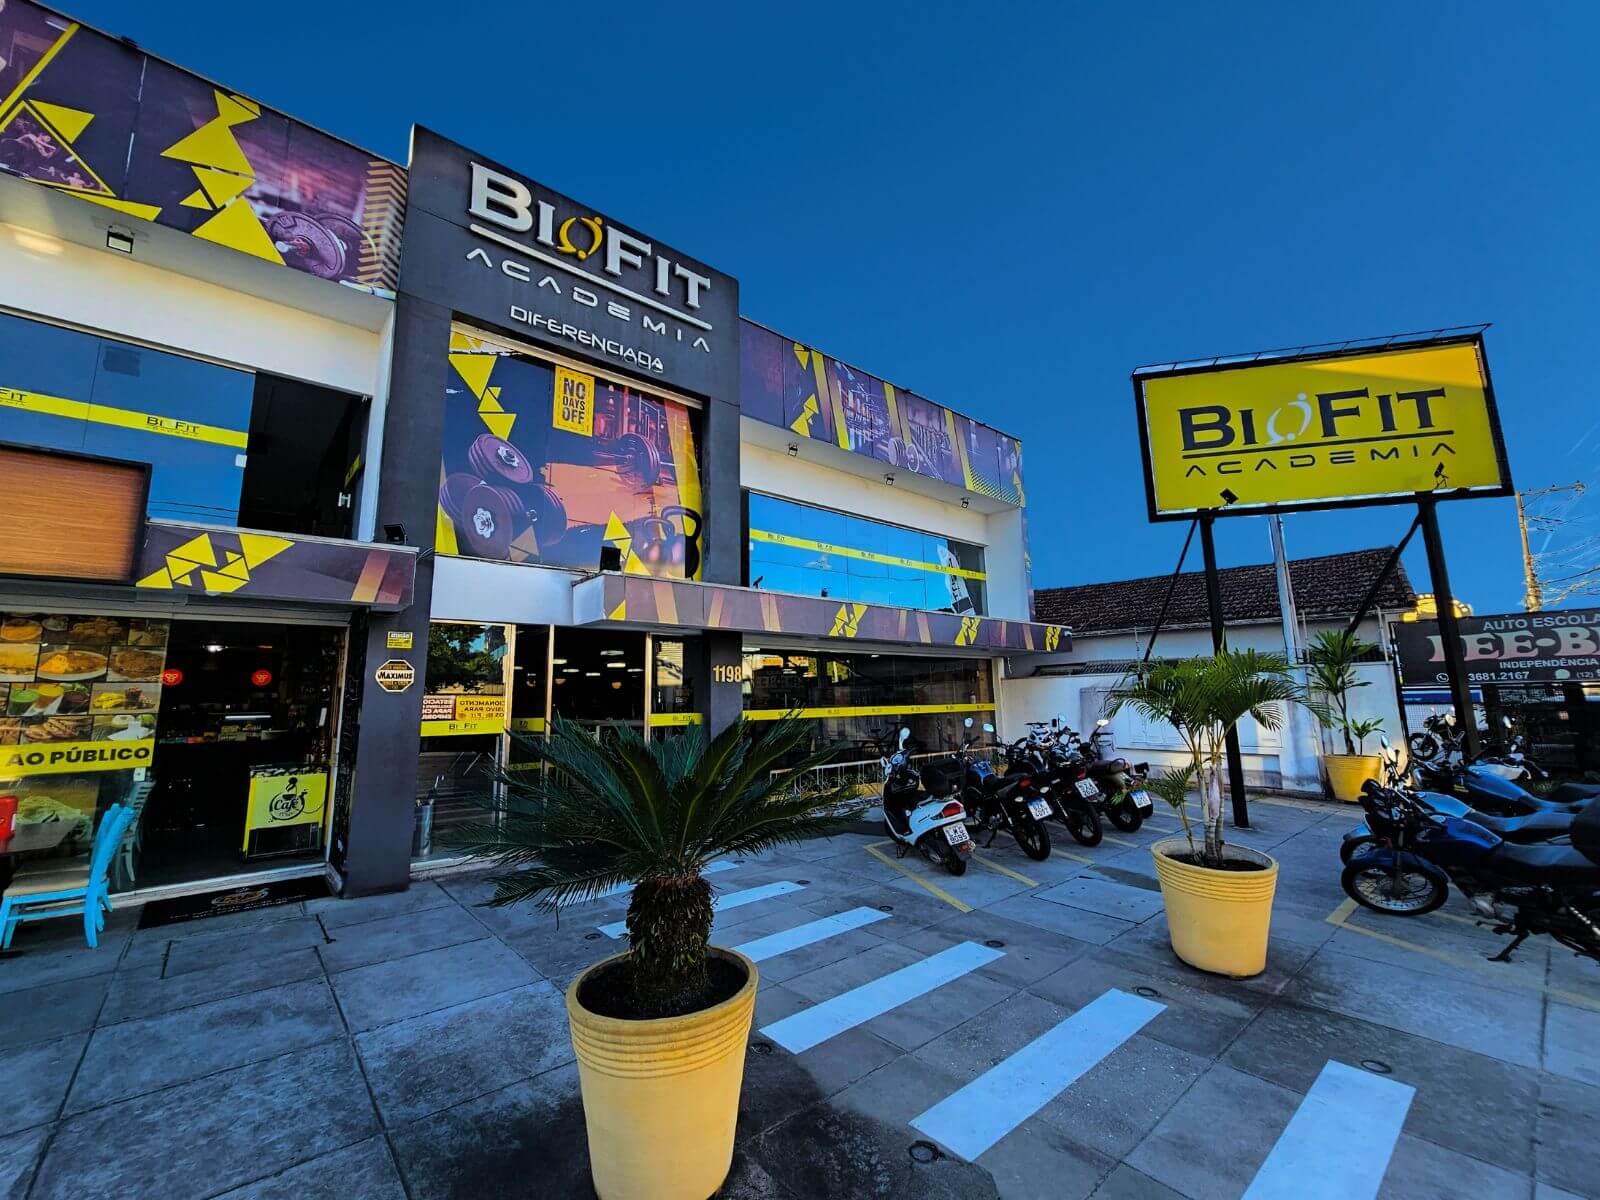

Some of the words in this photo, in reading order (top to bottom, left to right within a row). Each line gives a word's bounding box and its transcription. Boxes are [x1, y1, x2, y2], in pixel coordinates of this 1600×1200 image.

[466, 248, 711, 352] ACADEMIA
[563, 377, 586, 400] NO
[562, 395, 586, 411] DAYS
[562, 407, 586, 425] OFF
[1185, 442, 1456, 477] ACADEMIA
[1483, 618, 1528, 631] AUTO
[1499, 657, 1599, 669] INDEPENDÊNCIA
[713, 665, 742, 683] 1198
[1467, 671, 1530, 681] 3681.2167
[6, 751, 45, 766] AO
[50, 747, 150, 764] PÚBLICO
